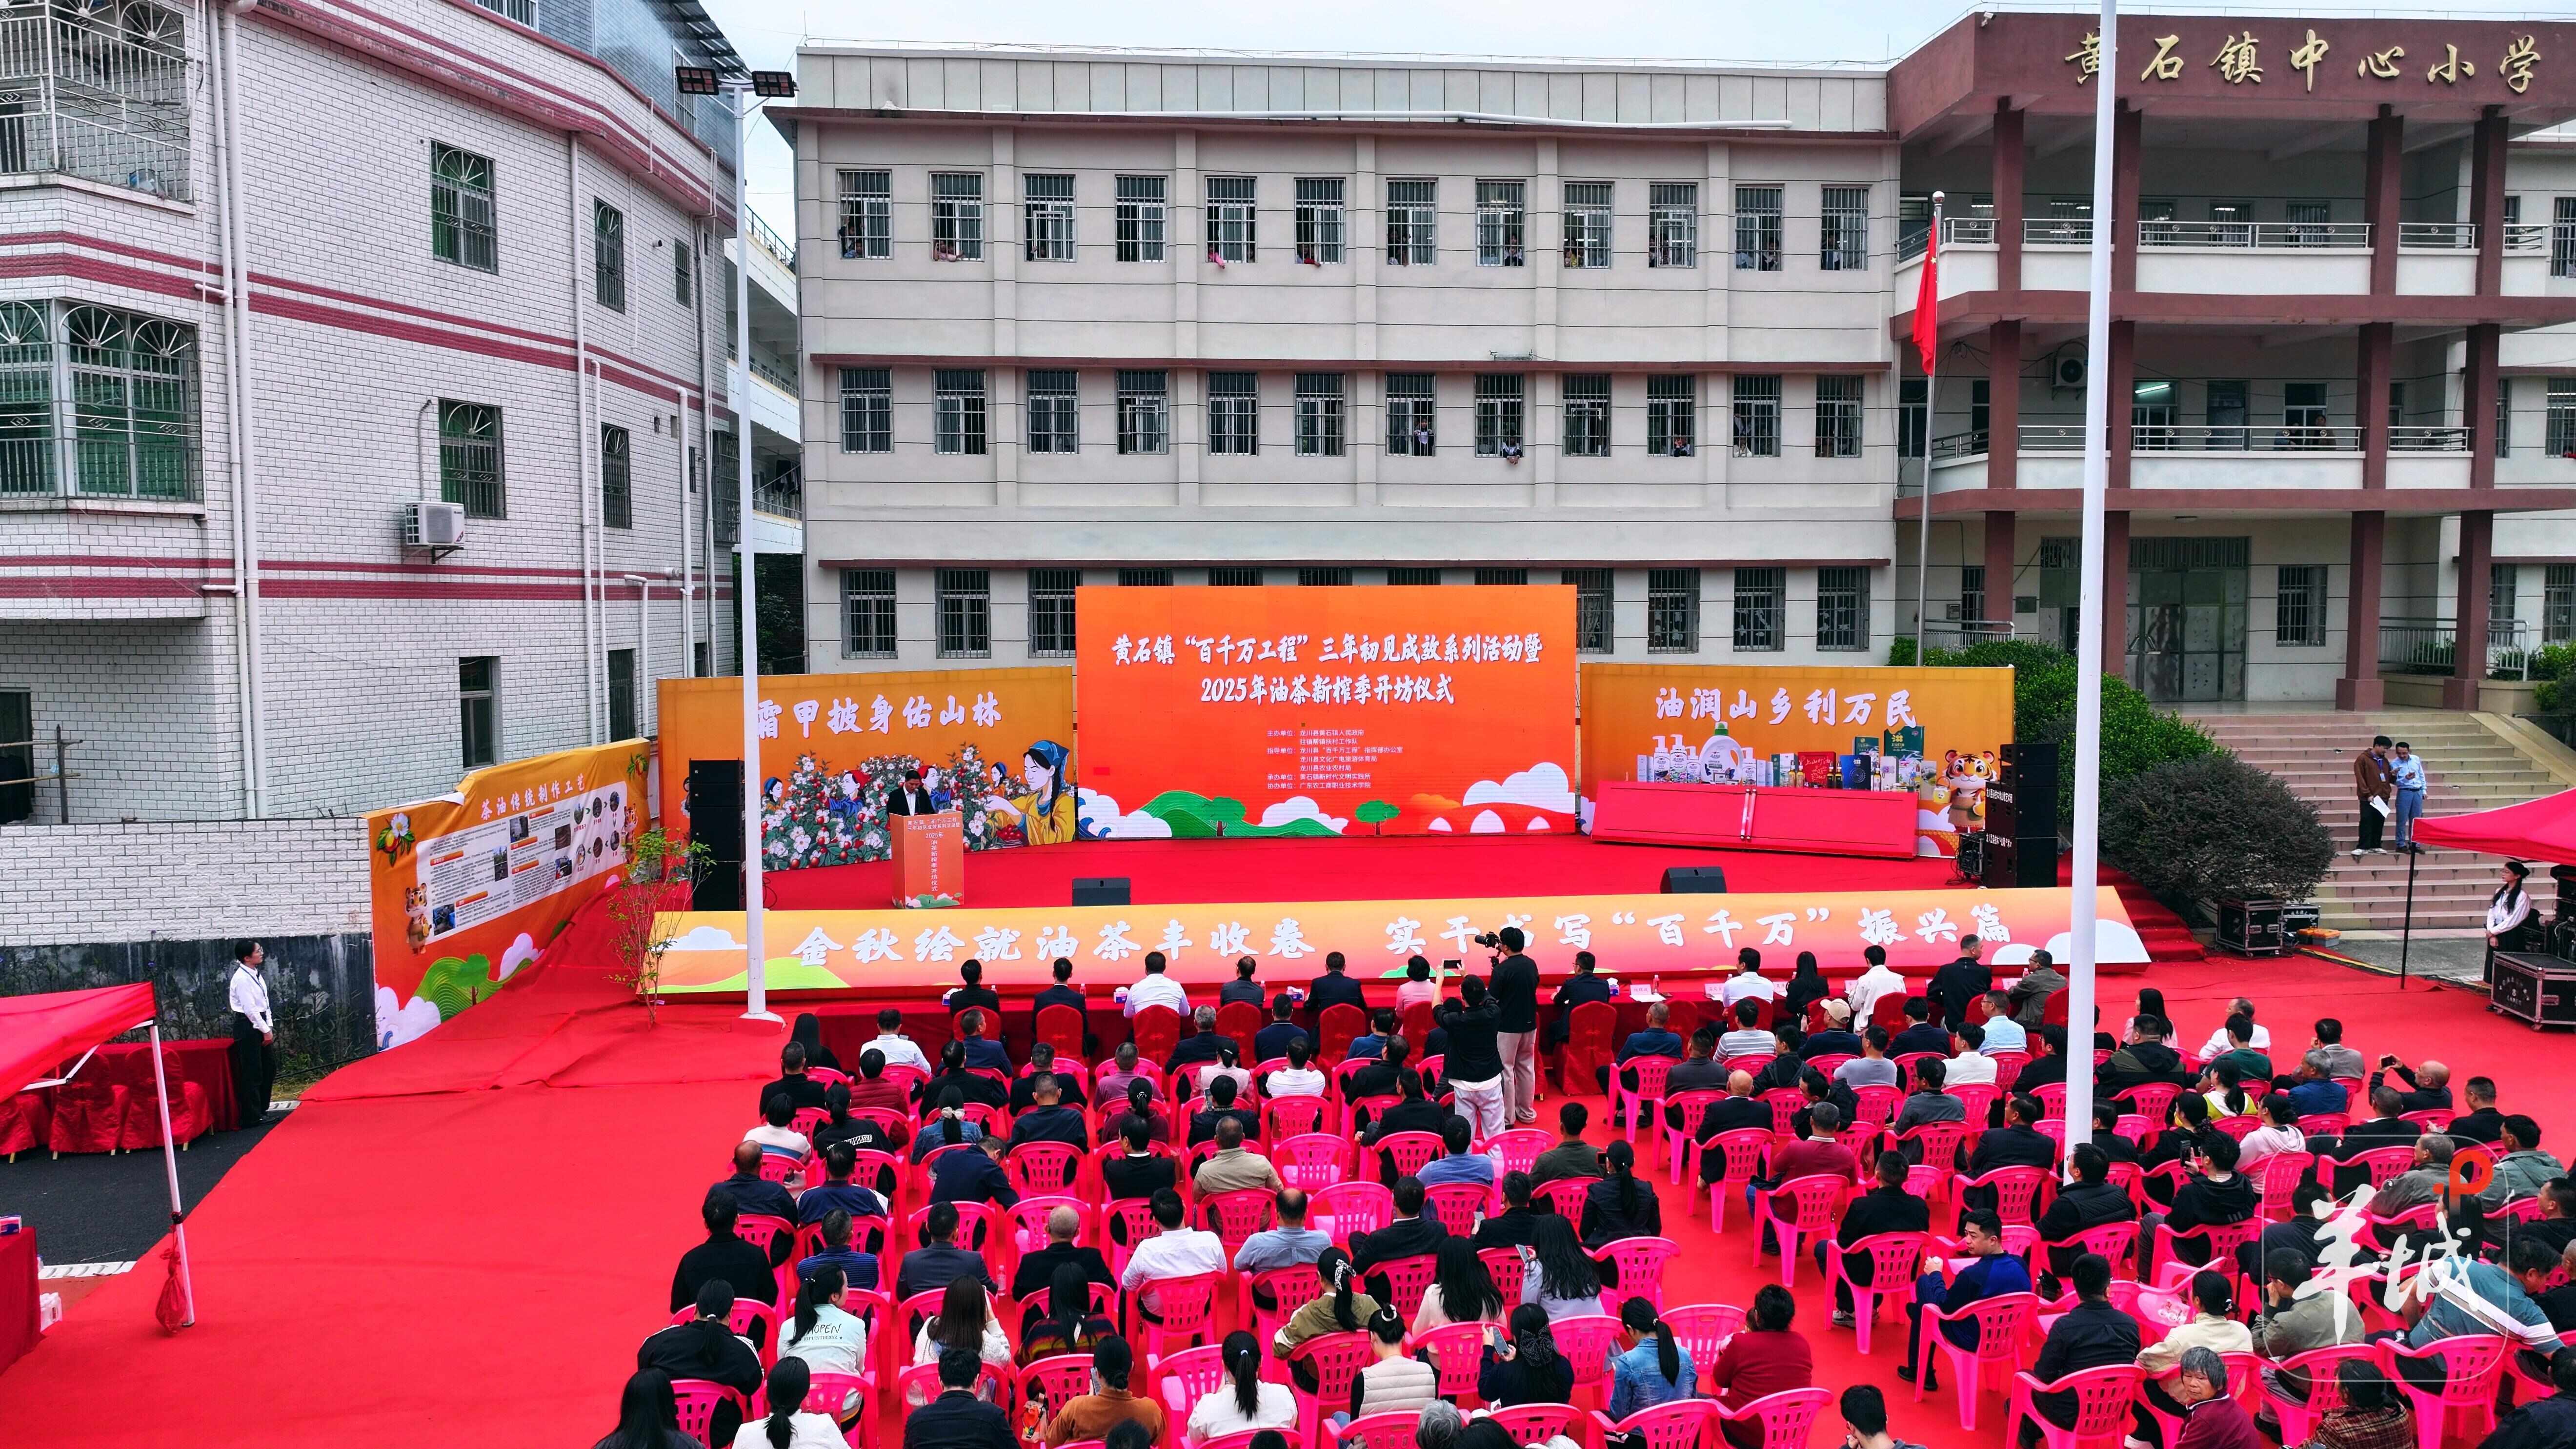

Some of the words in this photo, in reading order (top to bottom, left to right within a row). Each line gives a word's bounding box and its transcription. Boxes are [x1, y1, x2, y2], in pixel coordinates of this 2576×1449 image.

[2065, 29, 2540, 93] 黄石镇中心小学
[1201, 673, 1454, 705] 2025年油茶新榨季开坊仪式
[1655, 687, 1916, 728] 油润山乡利万民
[758, 691, 1002, 740] 霜甲披身佑山林
[481, 773, 585, 820] 茶油传统制作工艺
[790, 918, 1316, 967] 金秋绘就油茶丰收卷
[850, 1134, 872, 1146] YOURSELF
